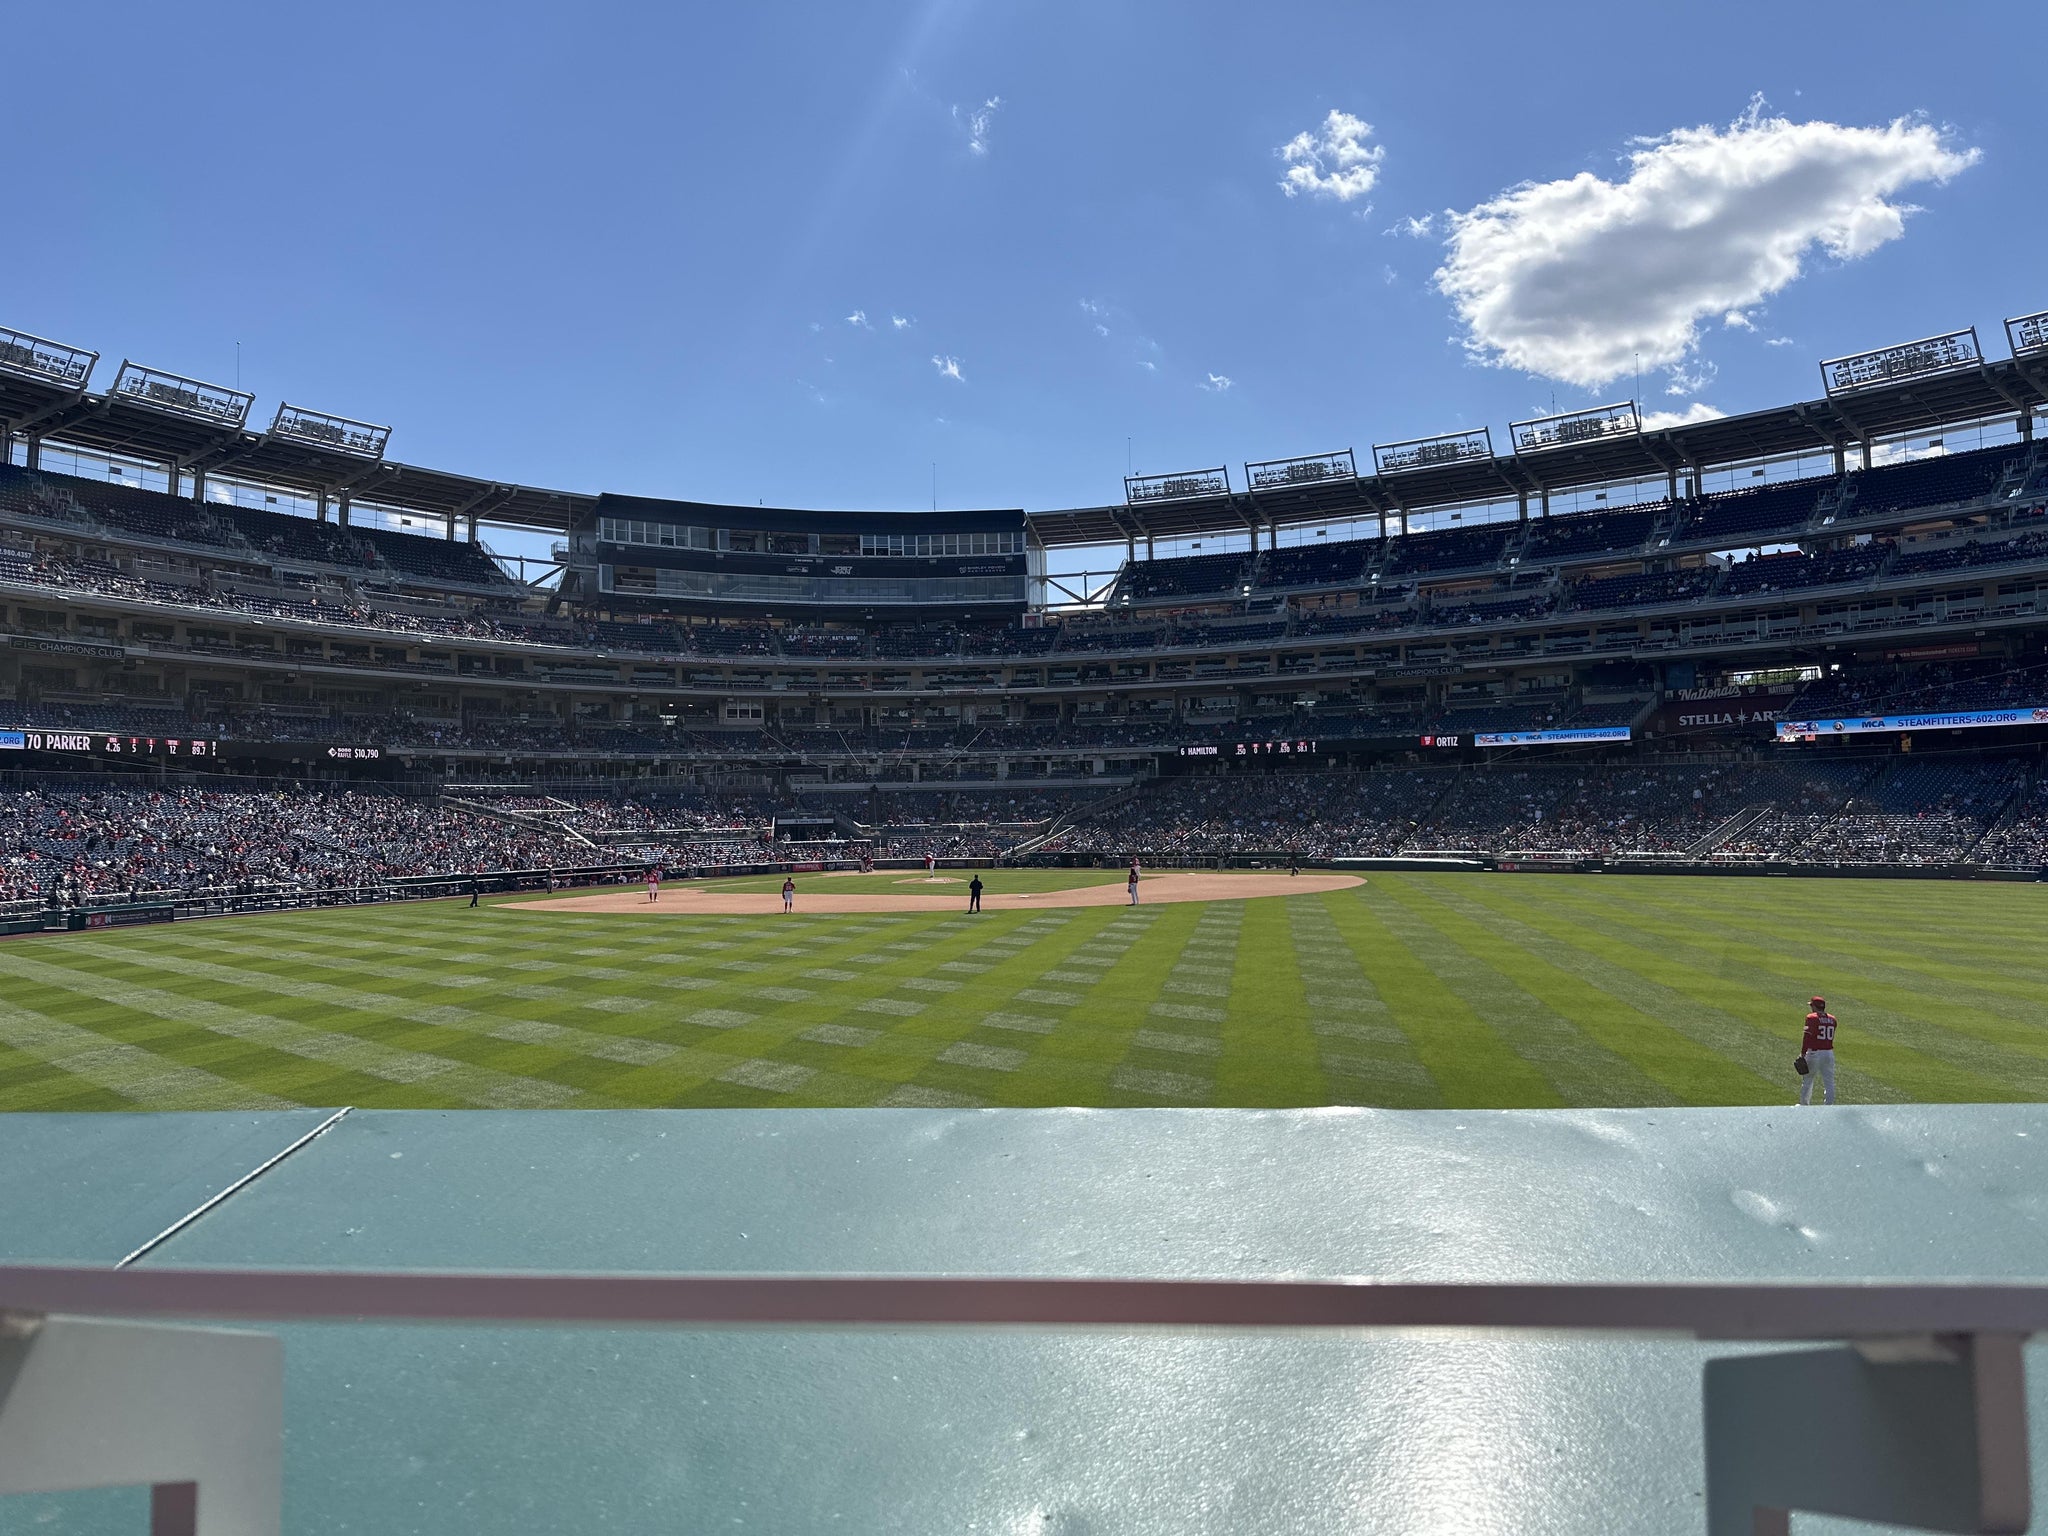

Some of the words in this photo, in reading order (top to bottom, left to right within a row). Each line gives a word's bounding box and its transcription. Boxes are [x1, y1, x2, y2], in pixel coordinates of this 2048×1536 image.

[40, 642, 96, 656] CHAMPIONS
[98, 648, 122, 658] CLUB
[1395, 668, 1440, 677] CHAMPIONS
[1440, 666, 1461, 674] CLUB
[1678, 686, 1741, 700] Nationals
[1679, 713, 1733, 726] STELLA
[1862, 720, 1885, 728] MCA
[1898, 713, 2017, 727] STEAMFITTERS-602.ORG
[27, 734, 41, 749] 70
[46, 735, 91, 751] PARKER
[1436, 736, 1458, 746] ORTIZ
[105, 743, 121, 753] 4.26
[131, 743, 137, 753] 5
[149, 744, 153, 753] 7
[169, 745, 177, 754] 12
[191, 746, 206, 755] 89.7
[354, 748, 379, 759] $10,790
[1180, 747, 1185, 756] 6
[1187, 747, 1218, 756] HAMILTON
[1817, 1025, 1834, 1040] 30
